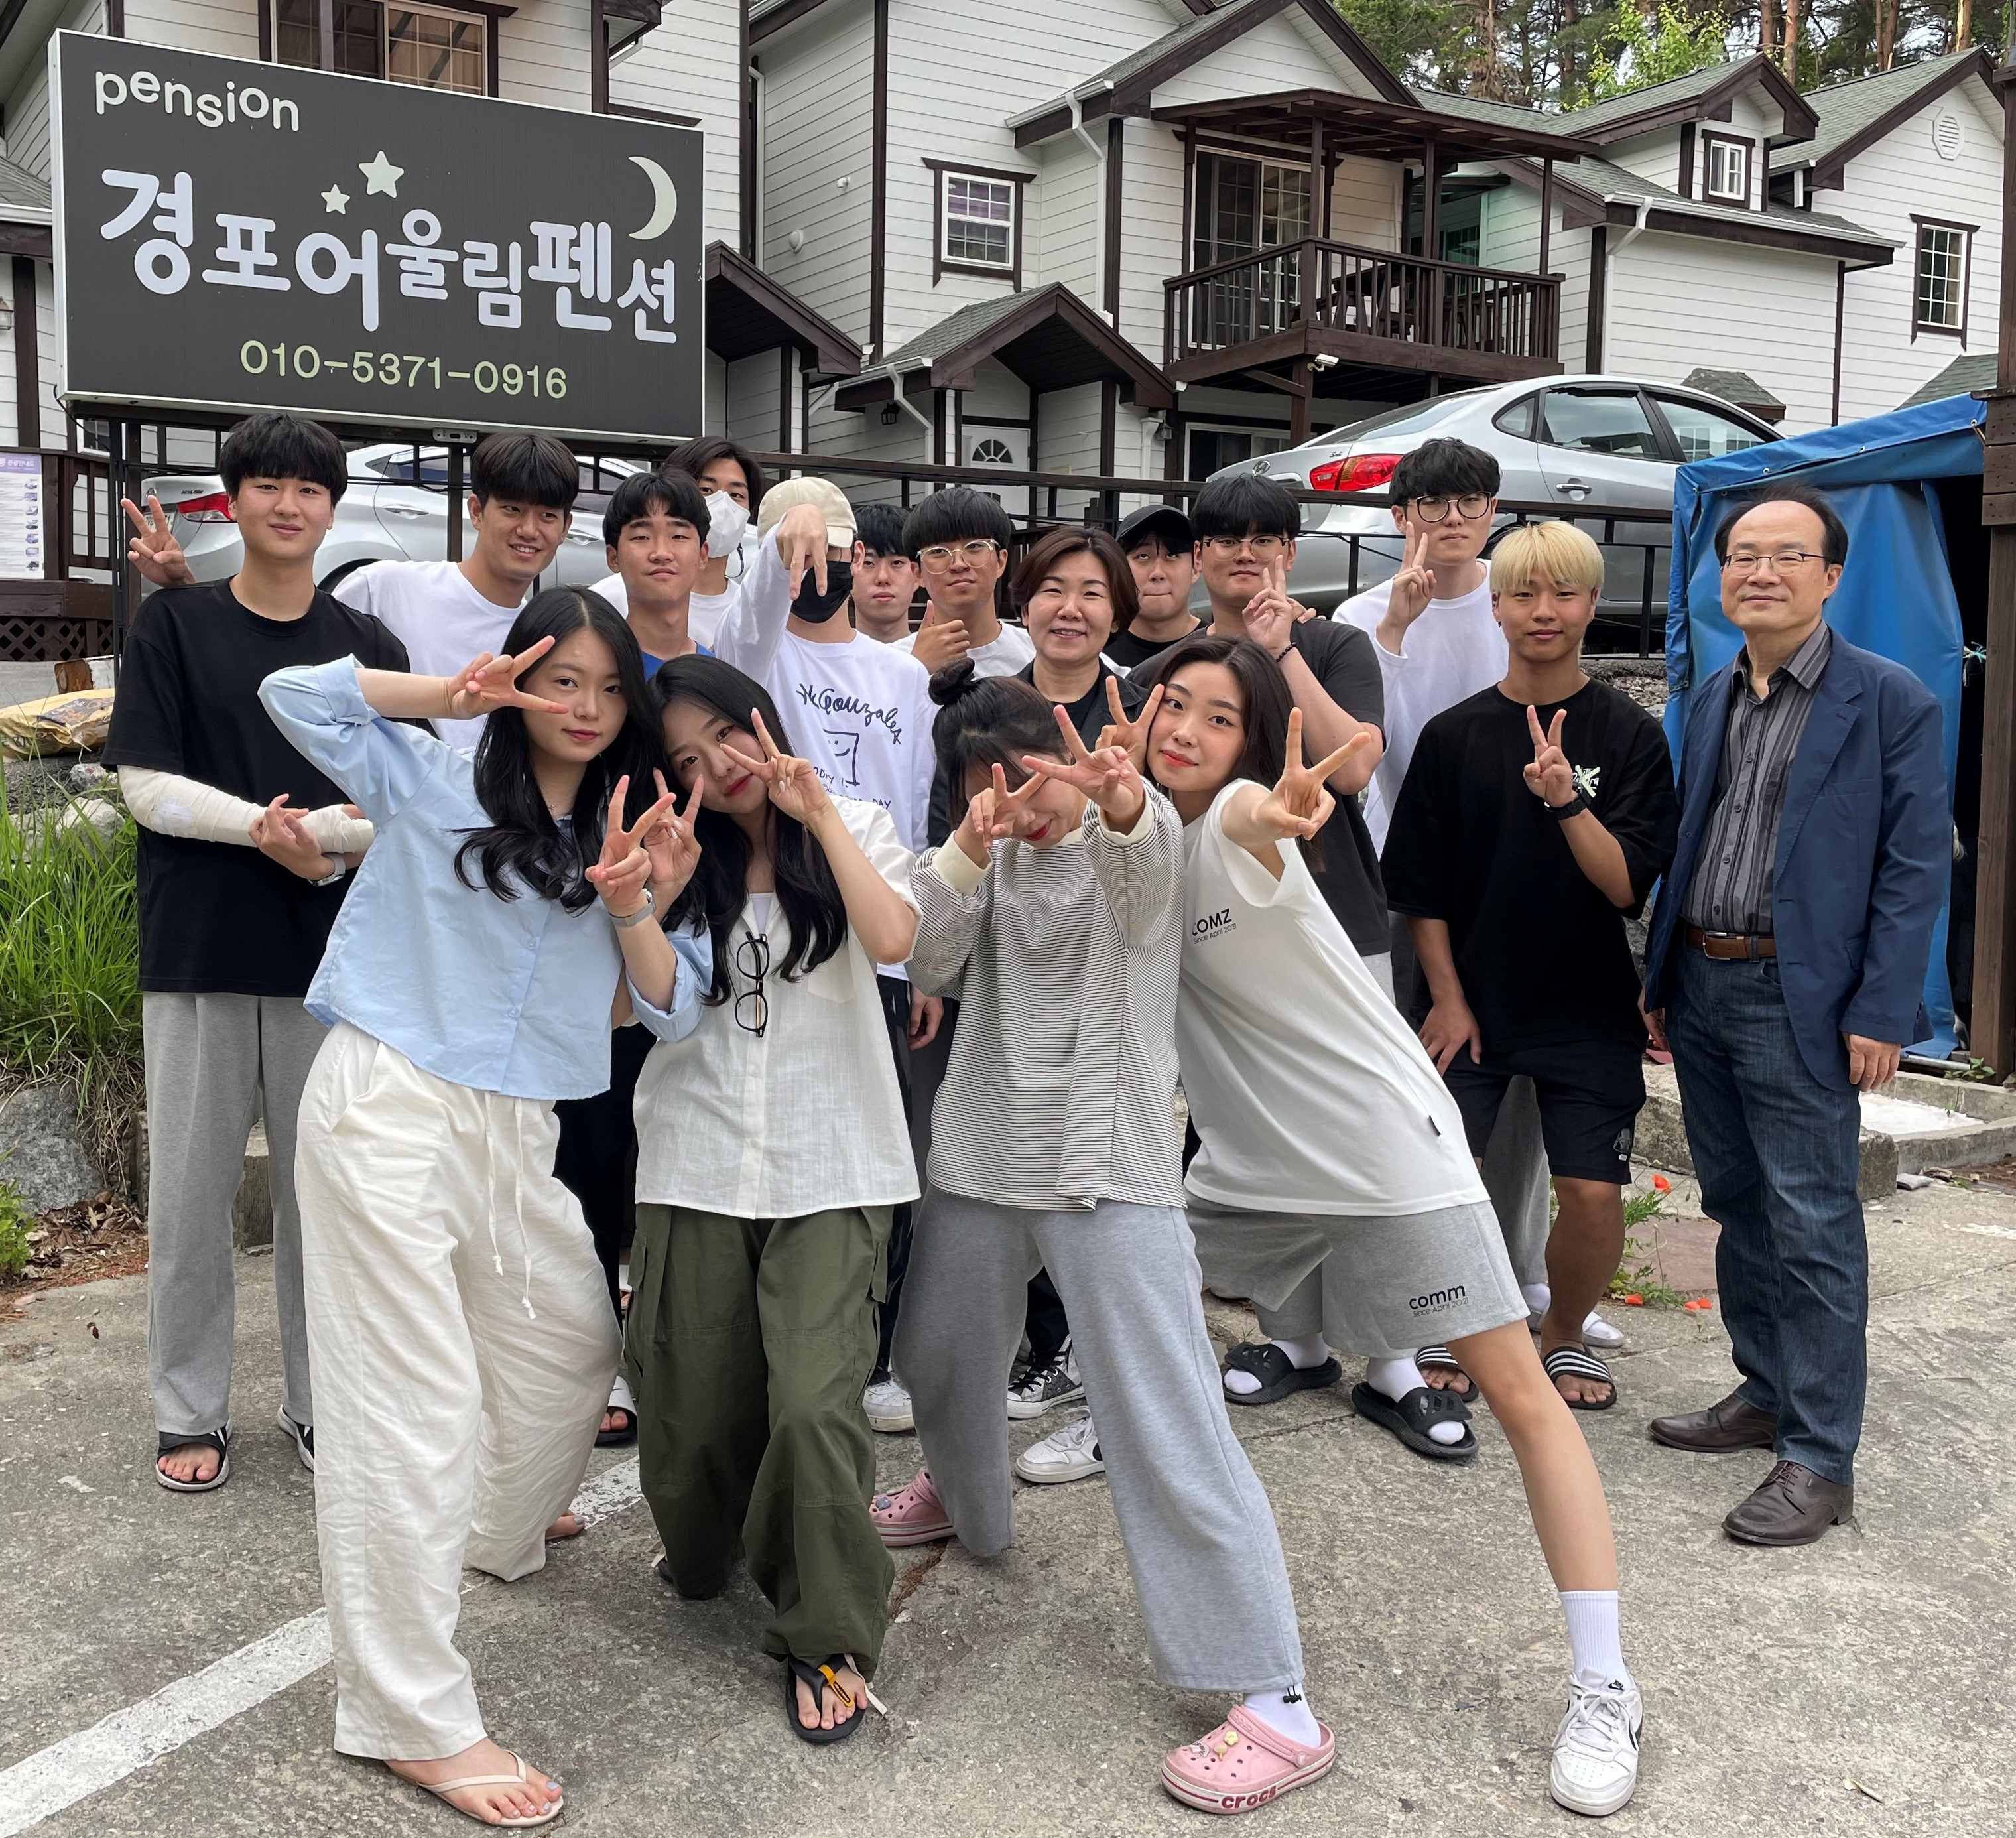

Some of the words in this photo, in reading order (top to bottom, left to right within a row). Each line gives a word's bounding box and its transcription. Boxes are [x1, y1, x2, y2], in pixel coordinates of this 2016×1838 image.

[95, 70, 299, 132] pension
[100, 169, 676, 344] 경포어울림펜션
[240, 340, 568, 399] 010-5371-0916
[1409, 1285, 1466, 1310] comm
[1222, 1785, 1277, 1809] crocs
